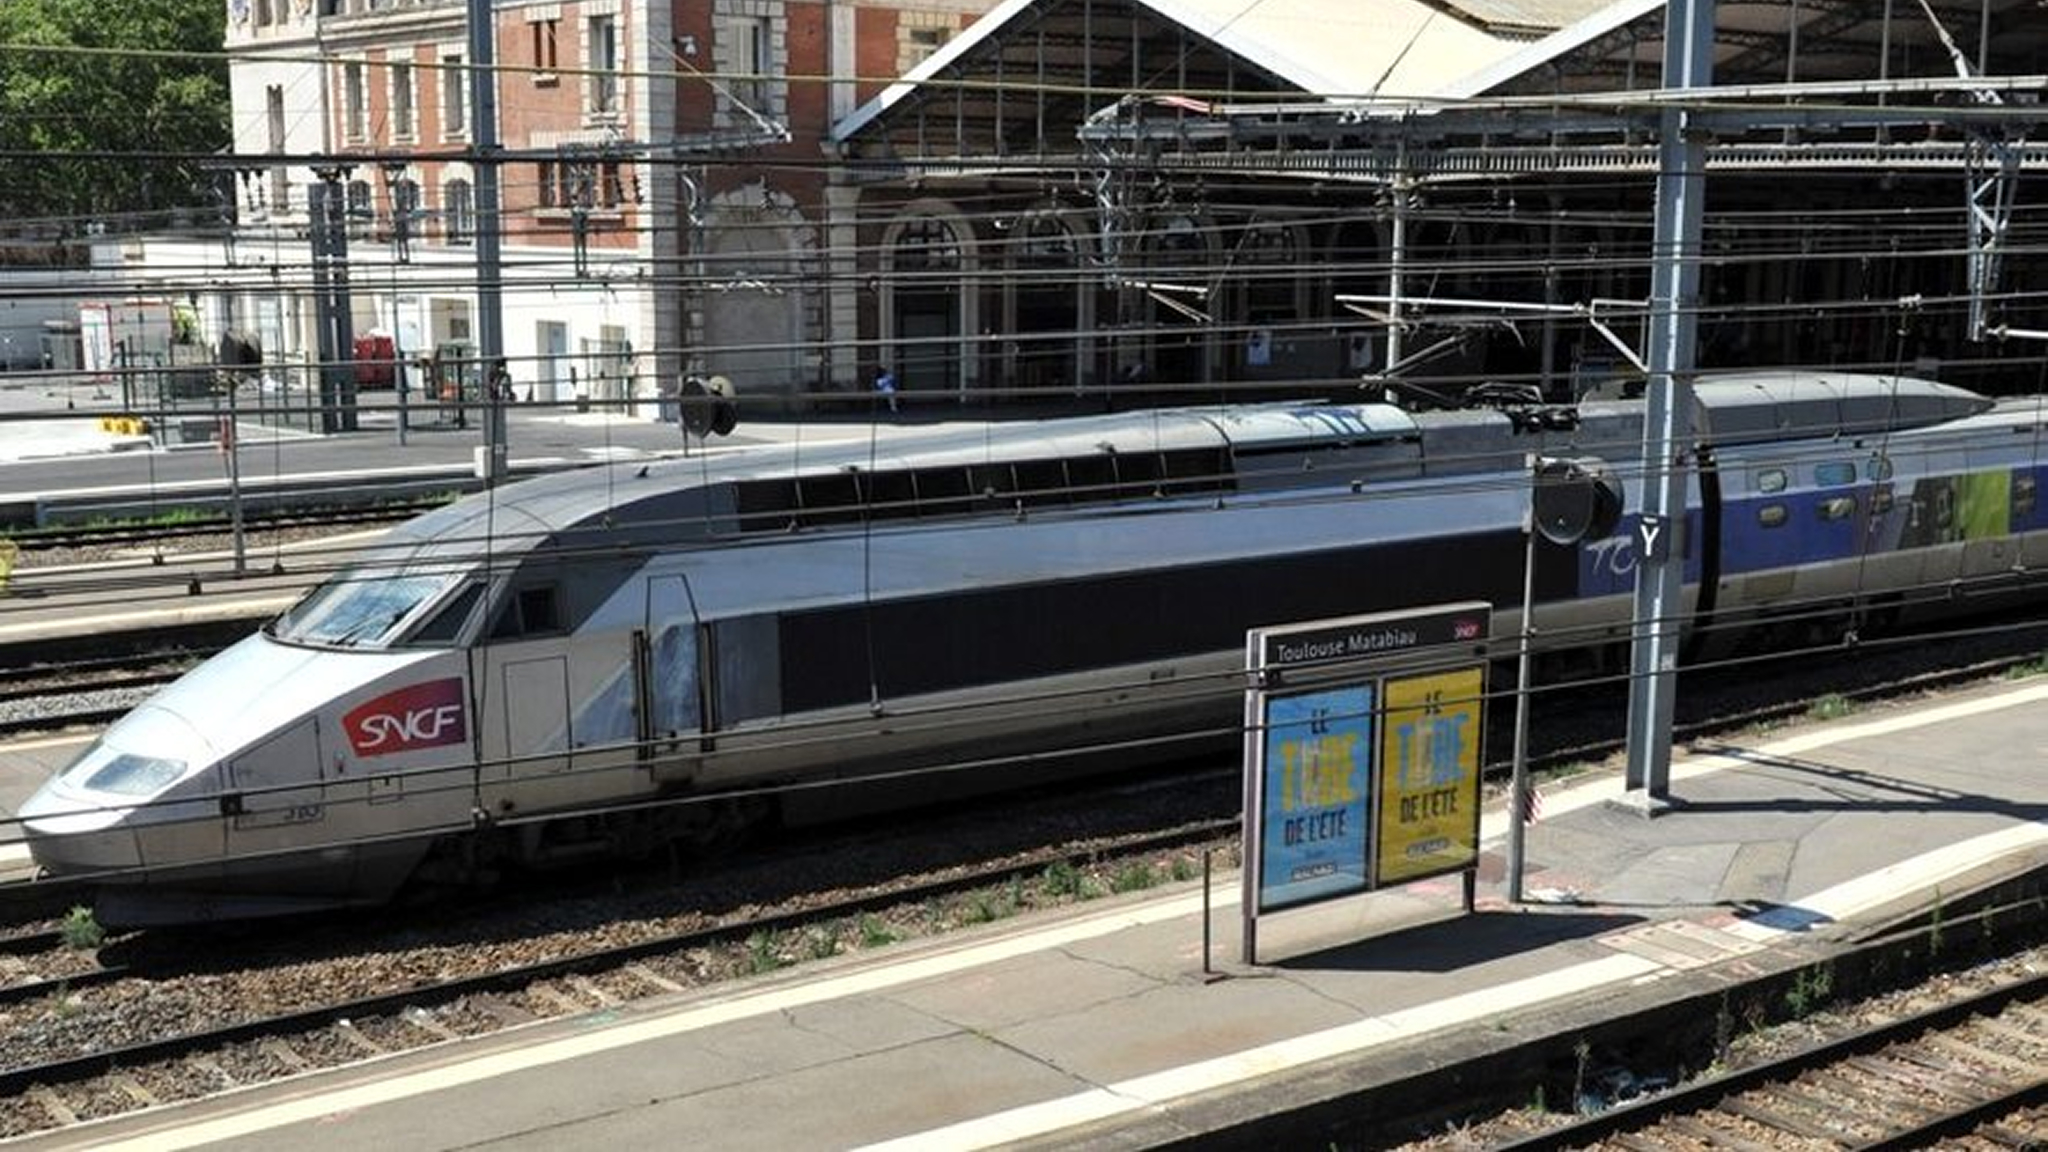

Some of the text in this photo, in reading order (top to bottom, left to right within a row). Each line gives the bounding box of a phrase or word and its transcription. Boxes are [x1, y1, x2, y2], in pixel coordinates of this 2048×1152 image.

[1641, 525, 1660, 556] Y
[1277, 629, 1417, 663] Toulouse Matabiau
[357, 704, 461, 748] SNCF
